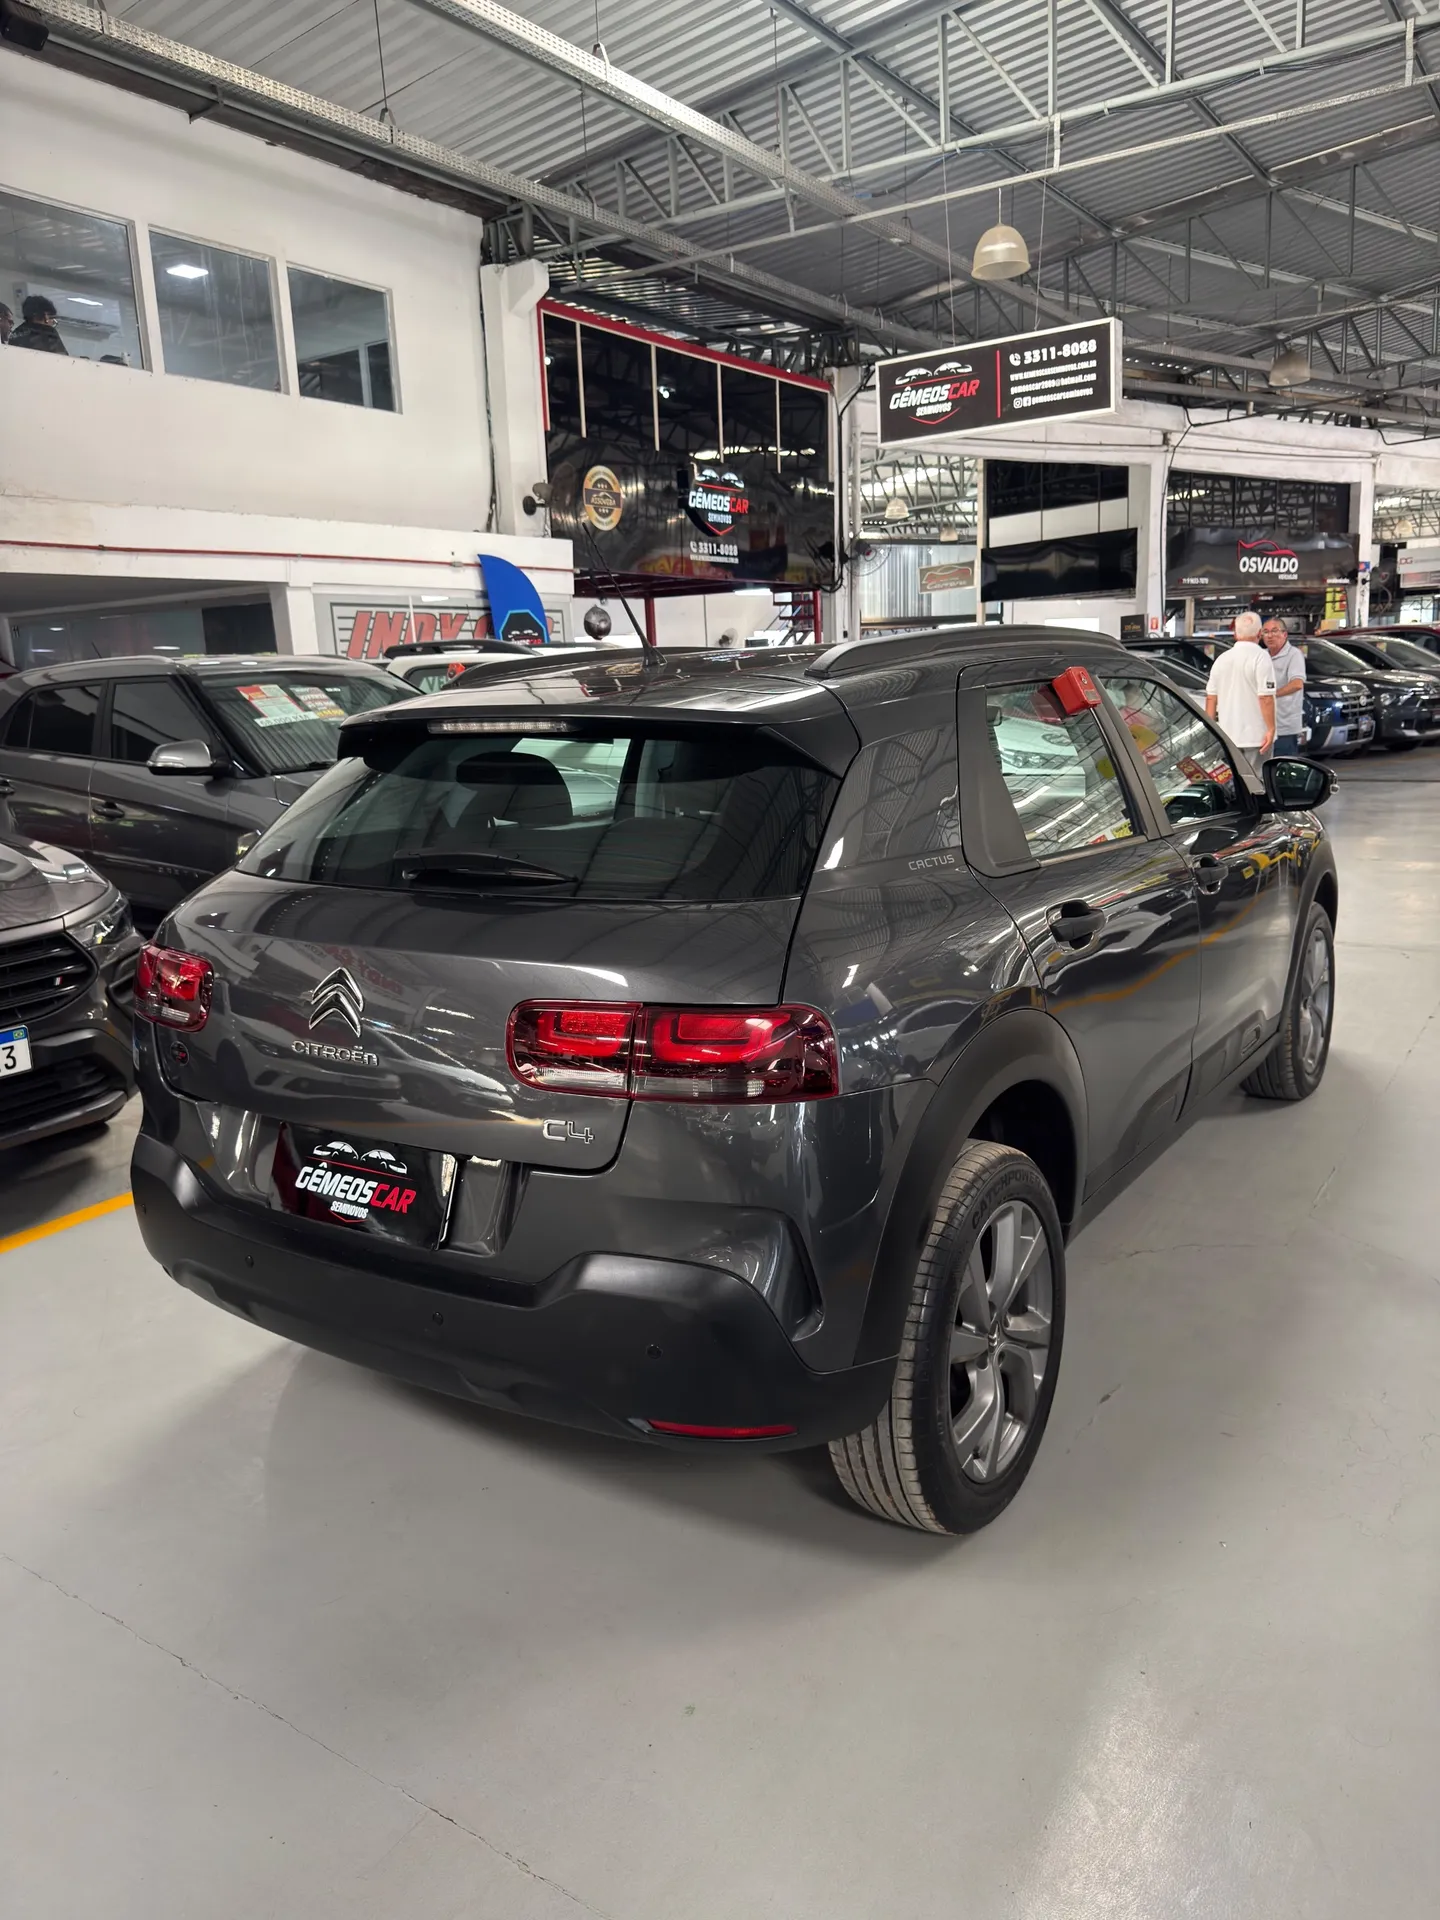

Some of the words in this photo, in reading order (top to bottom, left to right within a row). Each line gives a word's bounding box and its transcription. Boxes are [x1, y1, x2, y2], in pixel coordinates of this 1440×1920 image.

[1023, 339, 1097, 365] 3311-8028
[889, 379, 980, 410] GÊMEOSCAR
[688, 487, 749, 514] GÊMEOSCAR
[698, 541, 738, 556] 3311-8028
[1239, 556, 1299, 573] OSVALDO
[908, 854, 955, 871] CACTUS
[542, 1118, 595, 1145] C4
[295, 1161, 417, 1214] GÊMEOSCAR
[330, 1200, 369, 1220] SEMINOVOS
